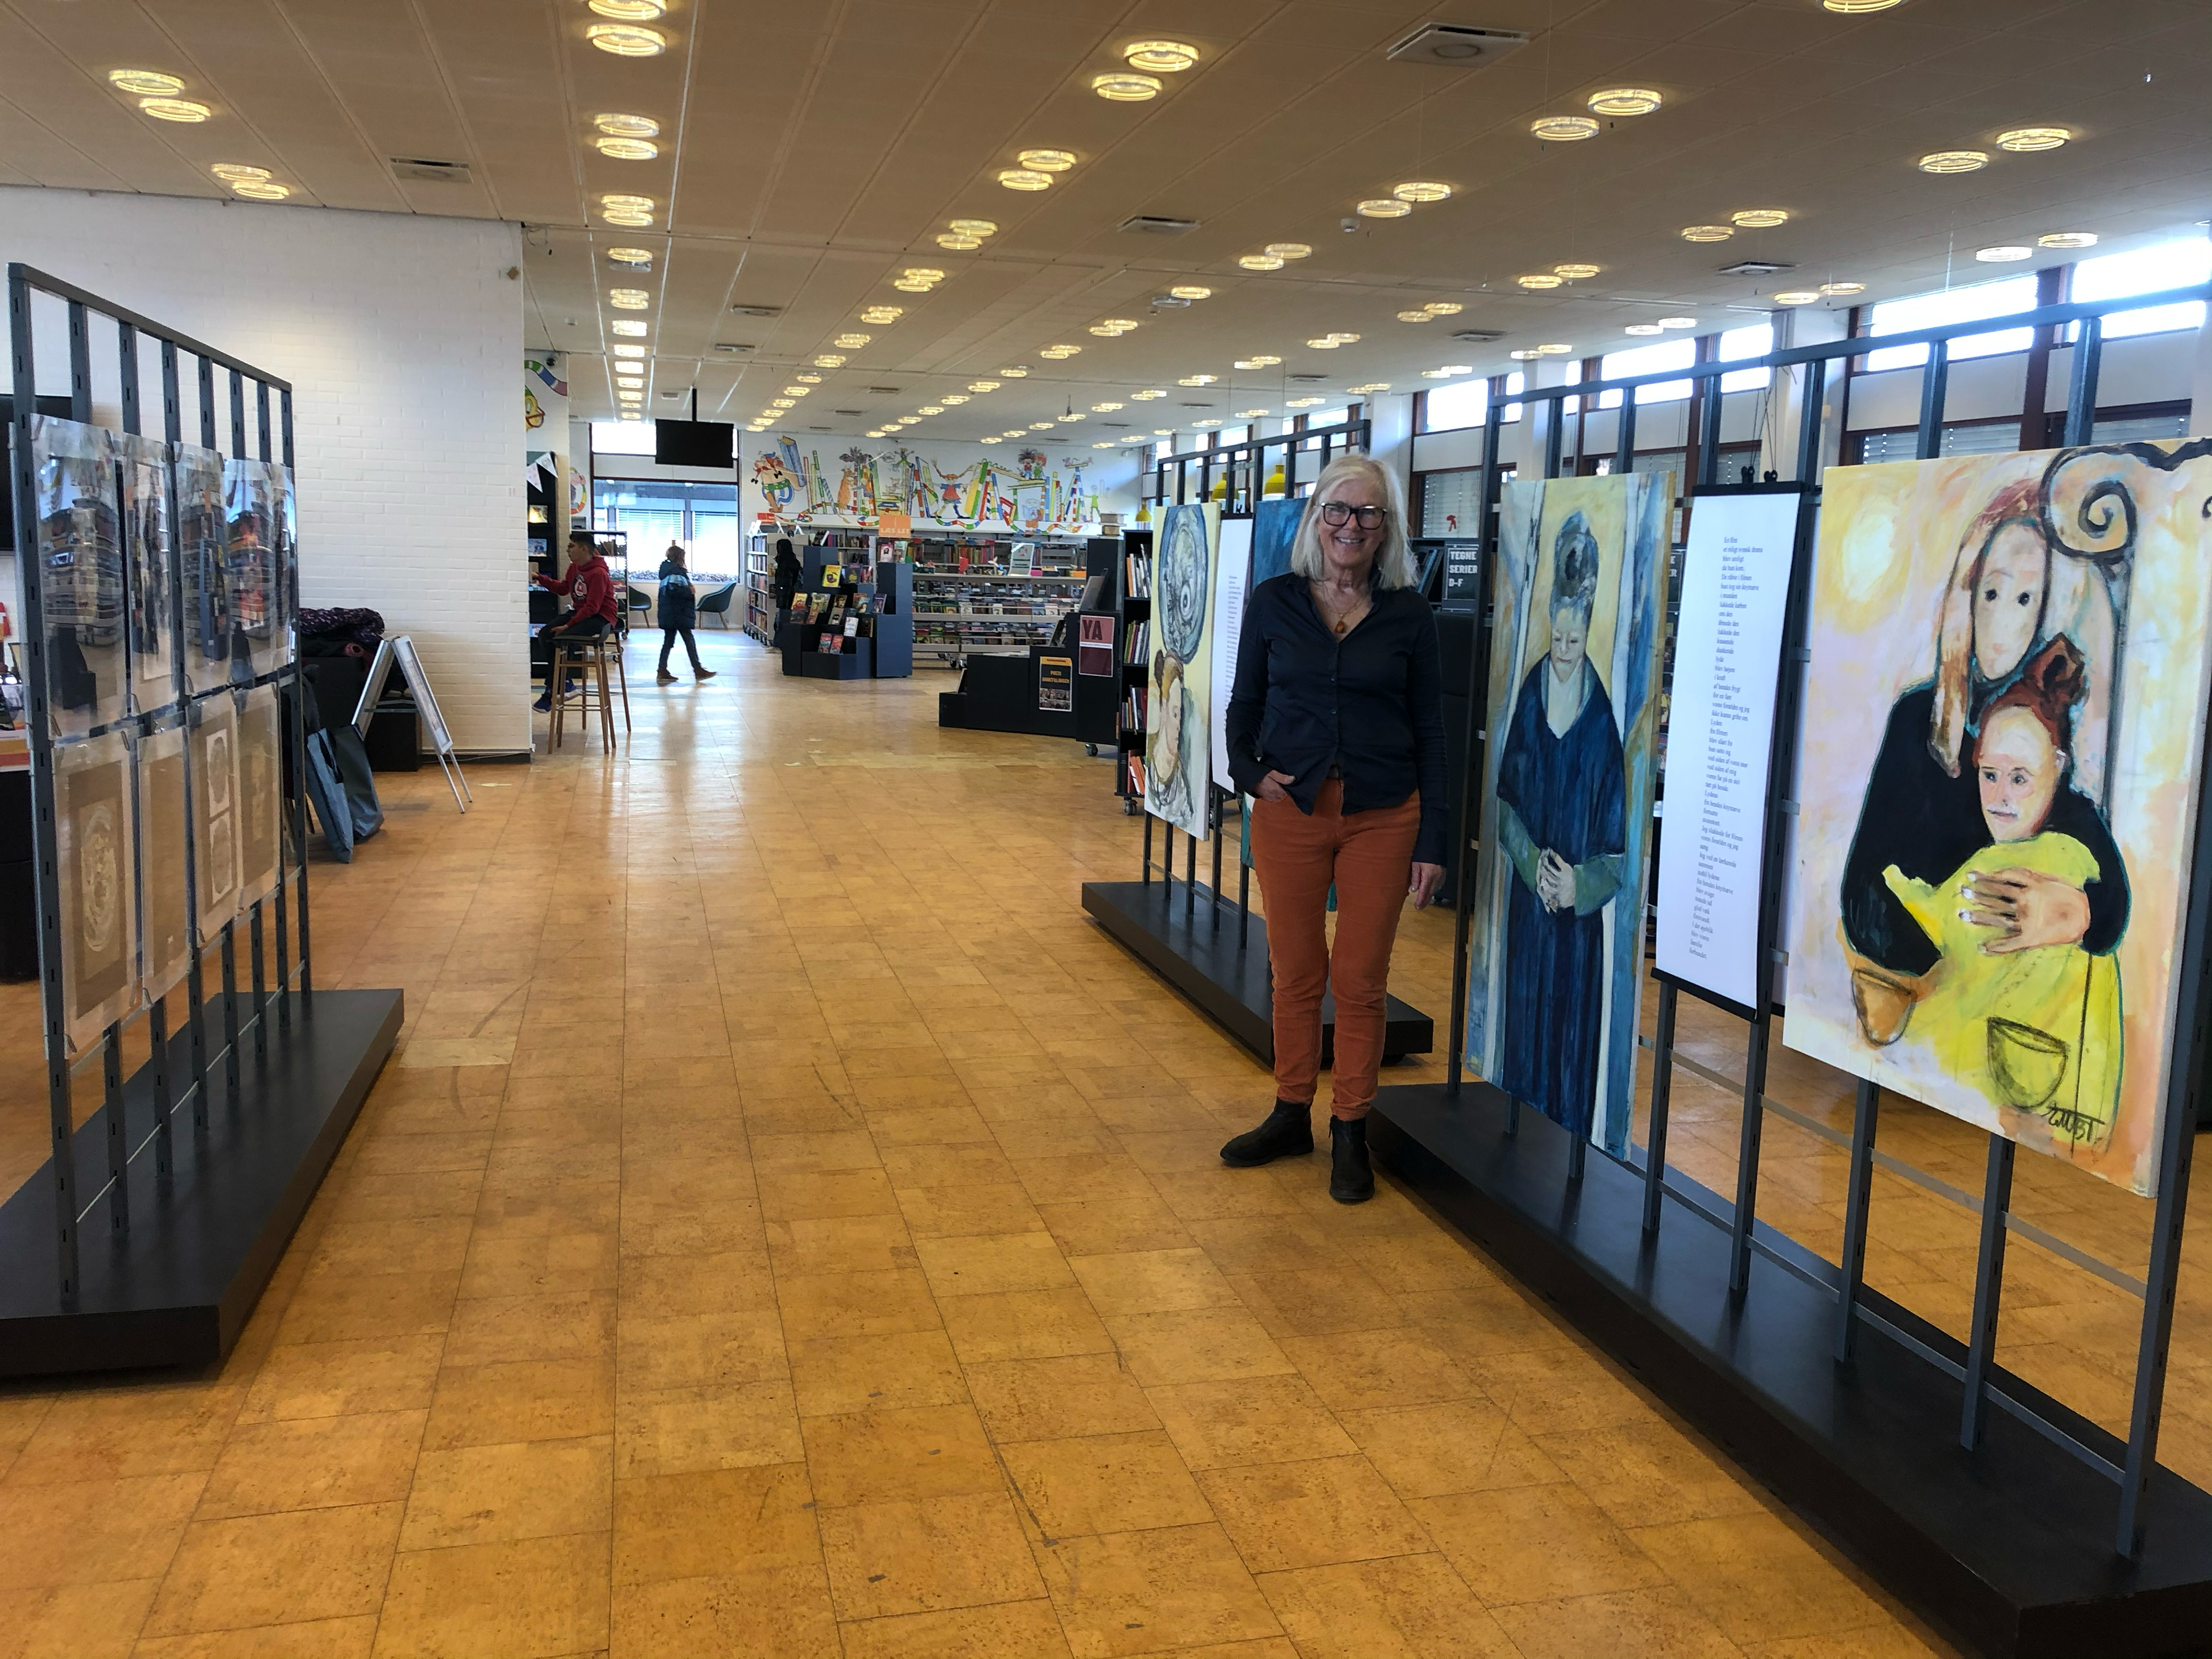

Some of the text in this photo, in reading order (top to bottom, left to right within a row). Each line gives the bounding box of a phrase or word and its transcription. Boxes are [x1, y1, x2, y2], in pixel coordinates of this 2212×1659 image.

[1450, 551, 1476, 560] TEGNE
[1449, 565, 1478, 574] SERIER
[1449, 578, 1464, 587] D-F
[1082, 619, 1103, 640] YA
